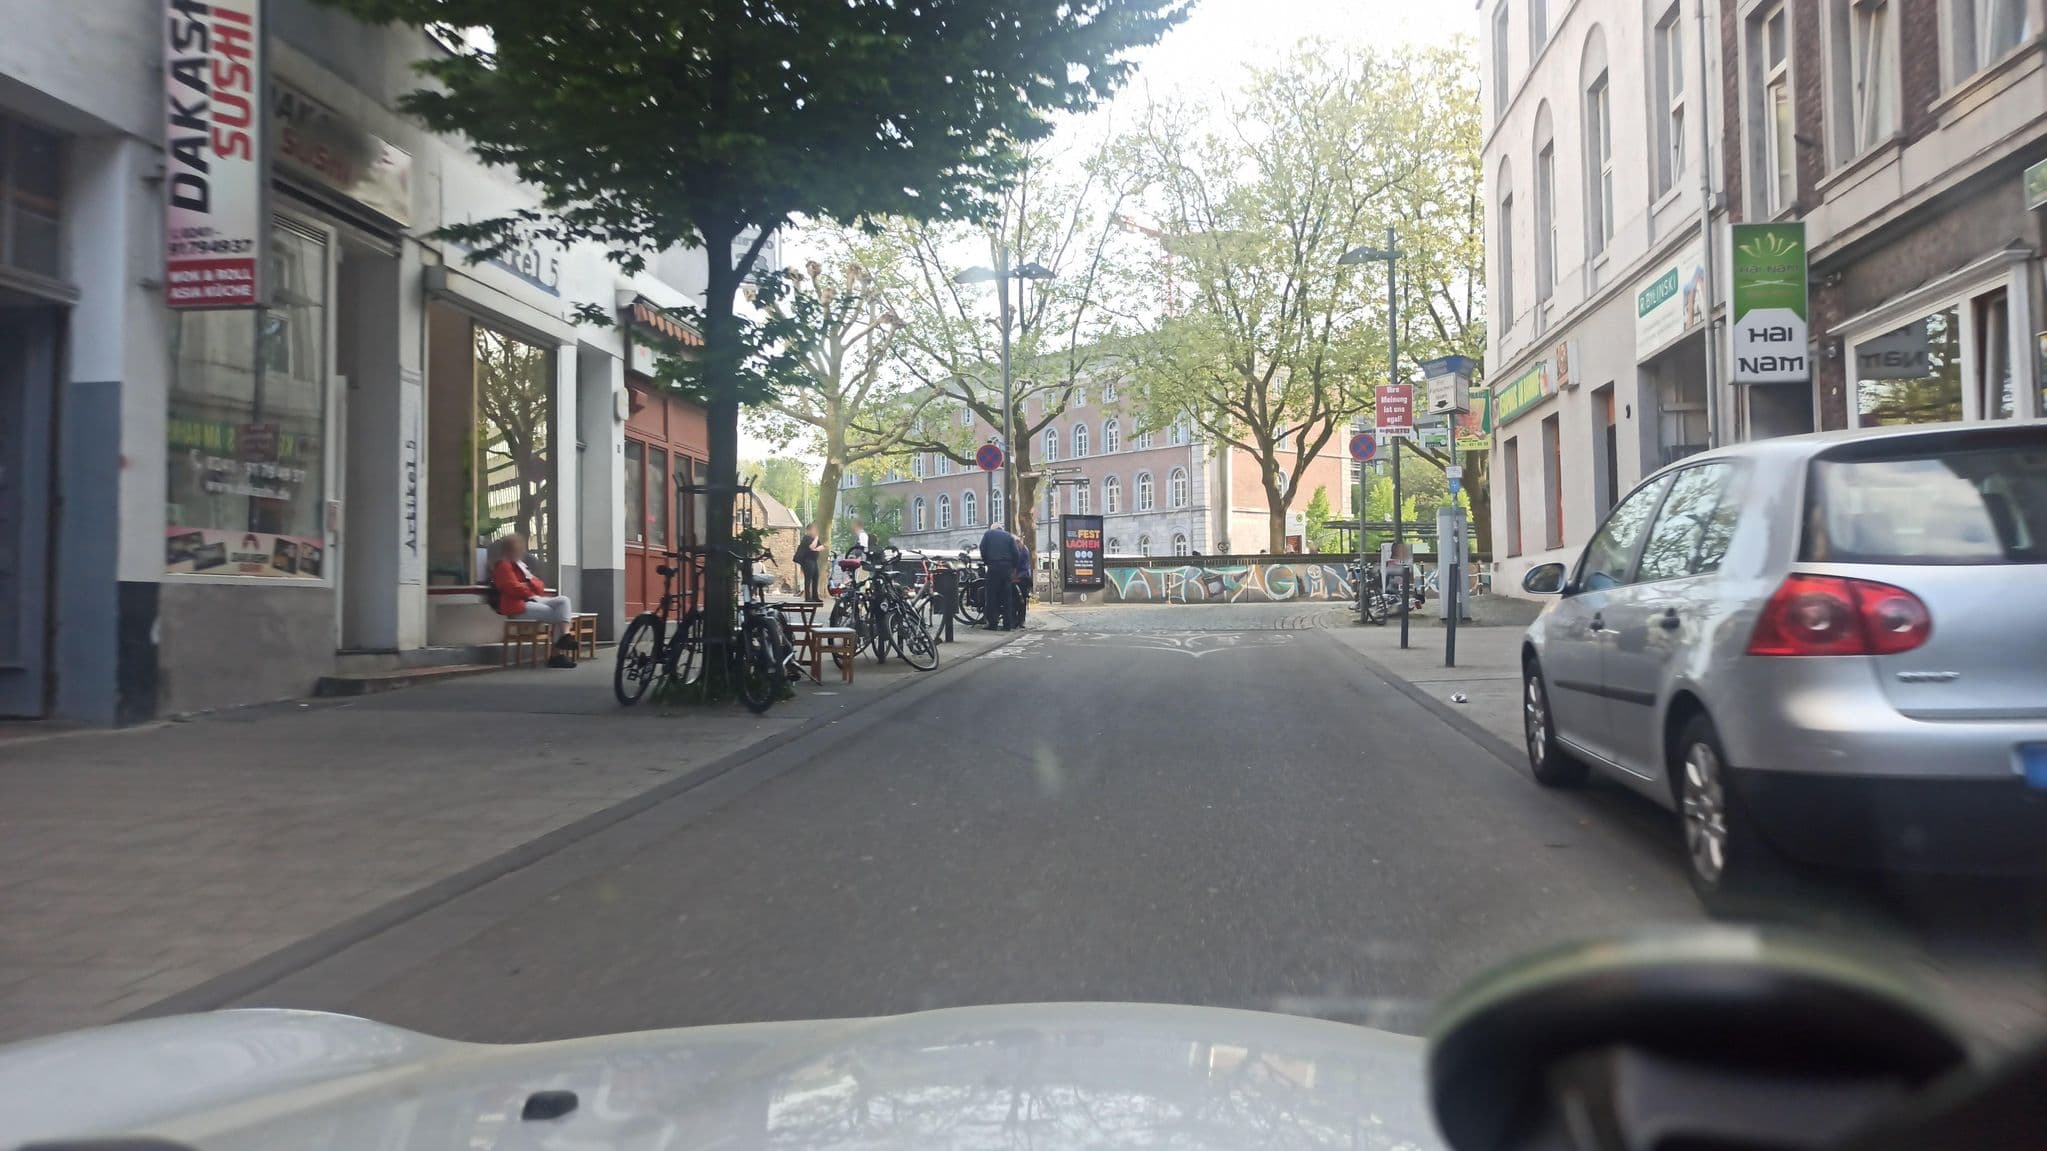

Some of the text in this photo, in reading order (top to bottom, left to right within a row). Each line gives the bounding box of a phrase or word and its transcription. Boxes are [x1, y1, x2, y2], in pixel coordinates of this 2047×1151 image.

[211, 6, 252, 161] SUSHI
[405, 461, 417, 557] Artikel
[1078, 529, 1101, 539] FEST
